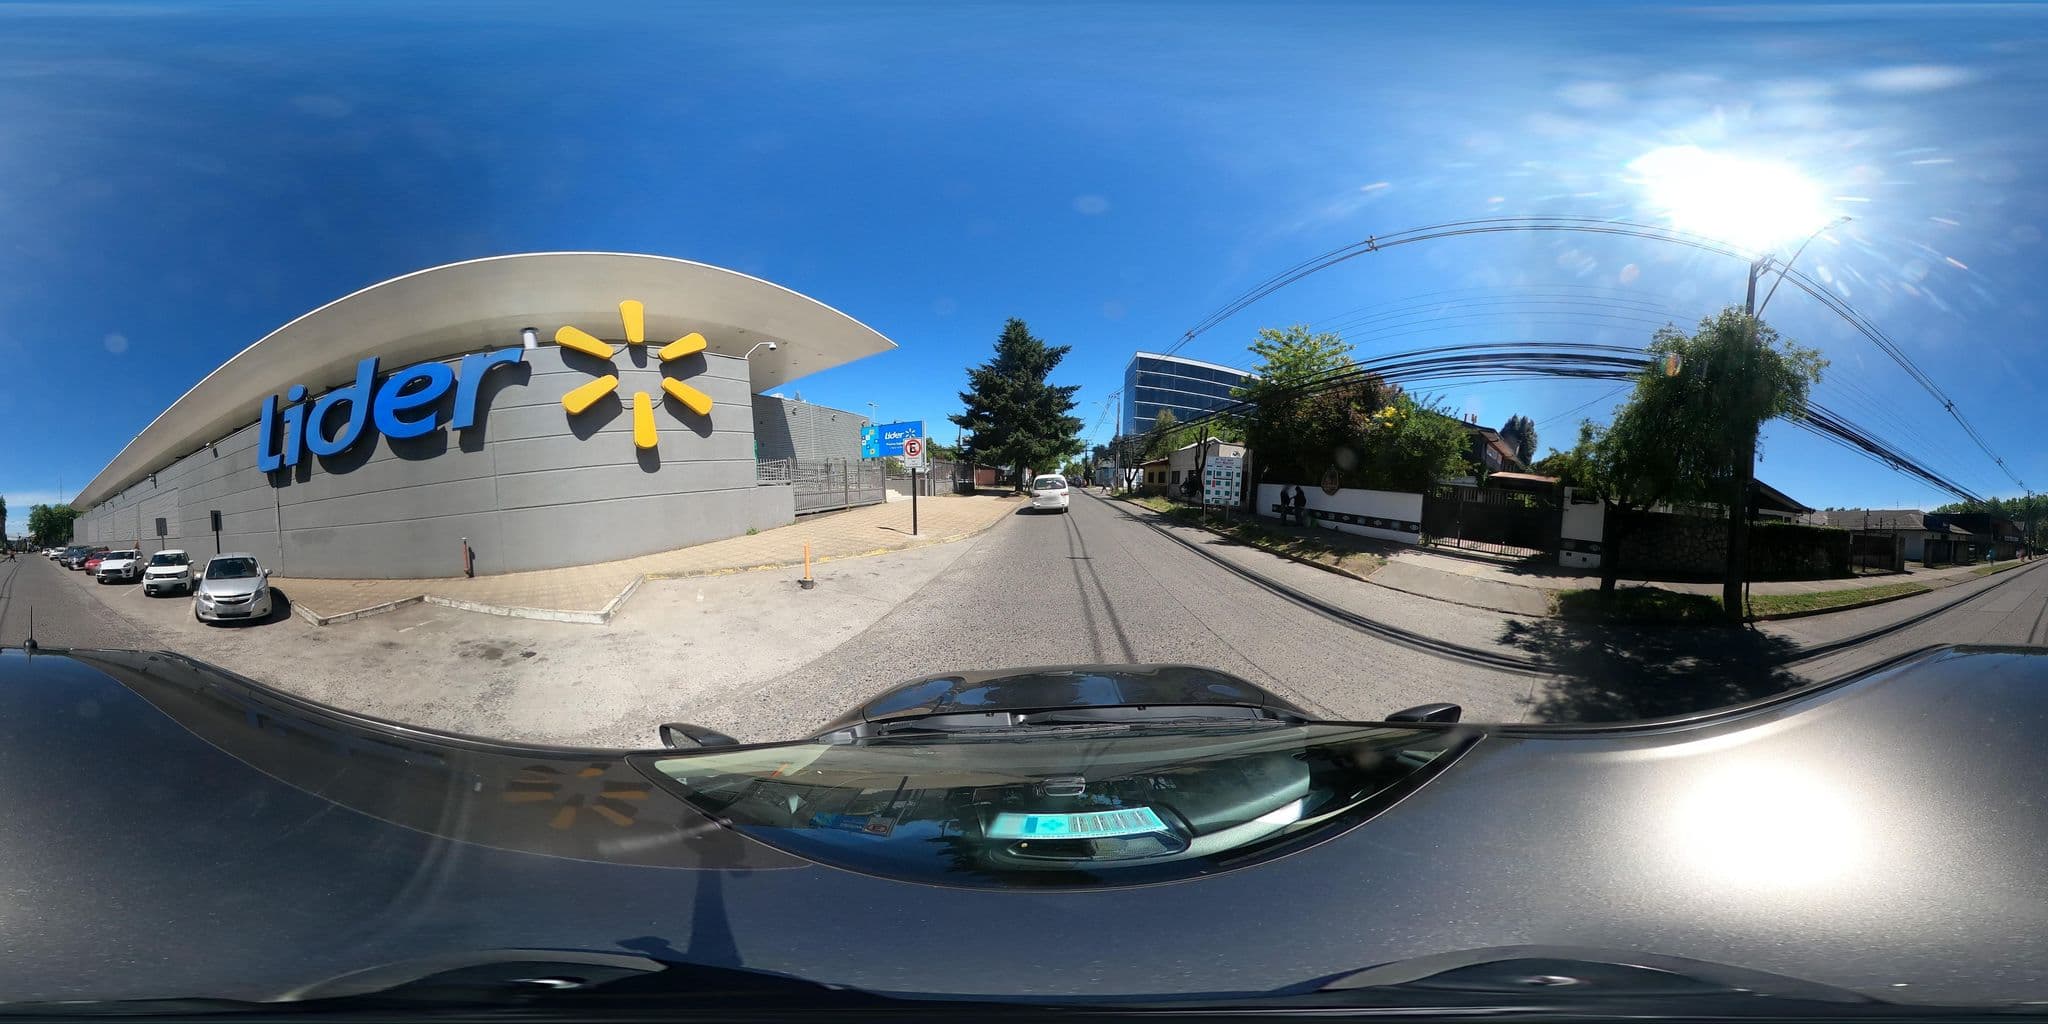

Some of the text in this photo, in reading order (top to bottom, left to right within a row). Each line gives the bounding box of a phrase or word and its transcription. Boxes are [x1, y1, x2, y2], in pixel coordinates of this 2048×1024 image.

[257, 348, 524, 473] Lider
[884, 431, 905, 440] Lider
[909, 442, 917, 453] E
